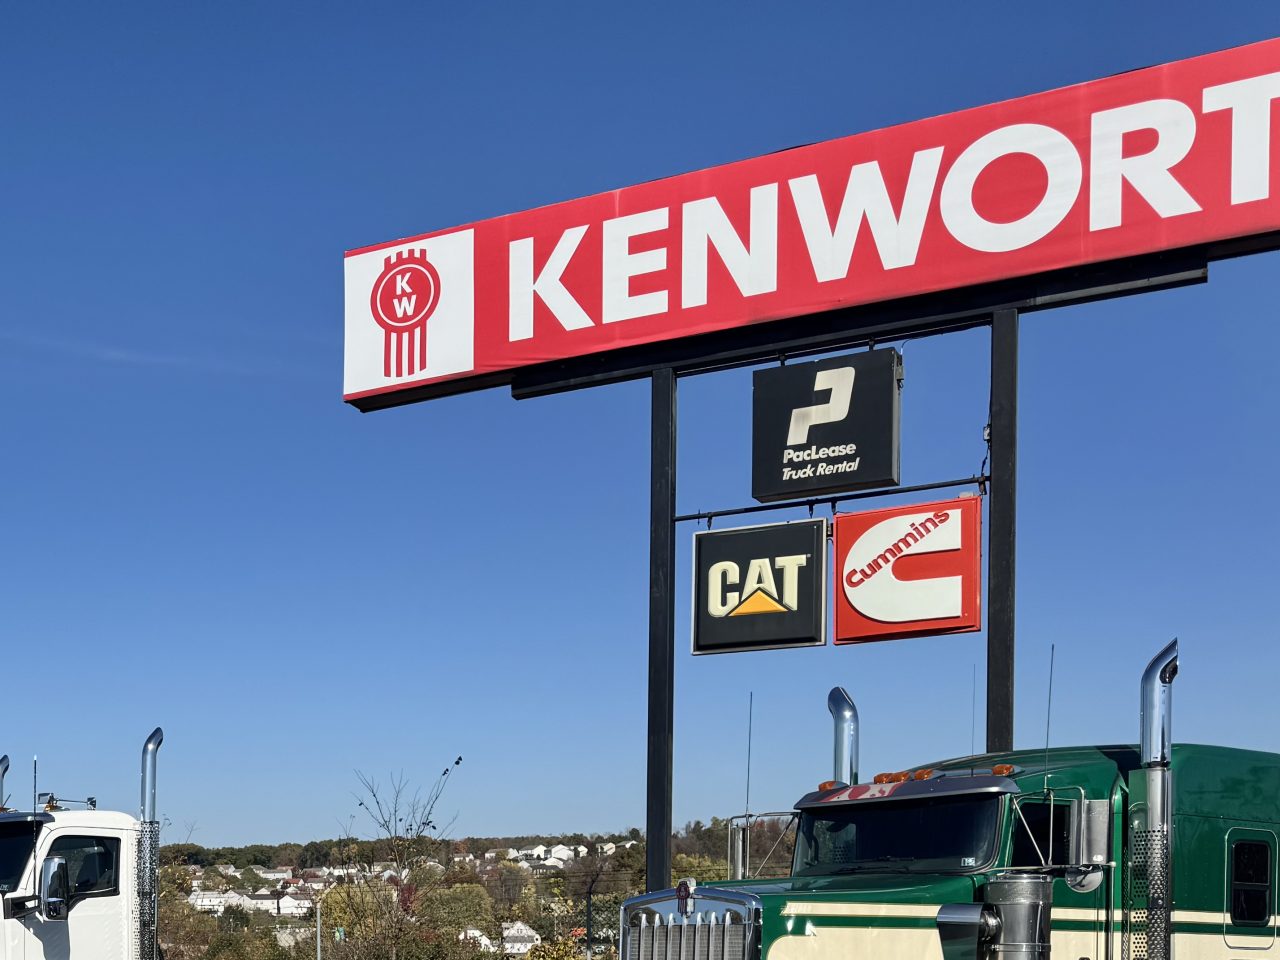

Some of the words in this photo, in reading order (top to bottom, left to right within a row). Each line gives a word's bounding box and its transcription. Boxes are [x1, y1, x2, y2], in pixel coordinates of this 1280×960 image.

[509, 71, 1280, 342] KENWORT
[782, 464, 815, 481] Truck
[816, 457, 860, 476] Rental
[783, 443, 857, 464] PacLease
[845, 511, 950, 588] Cummins
[708, 554, 807, 618] CAT
